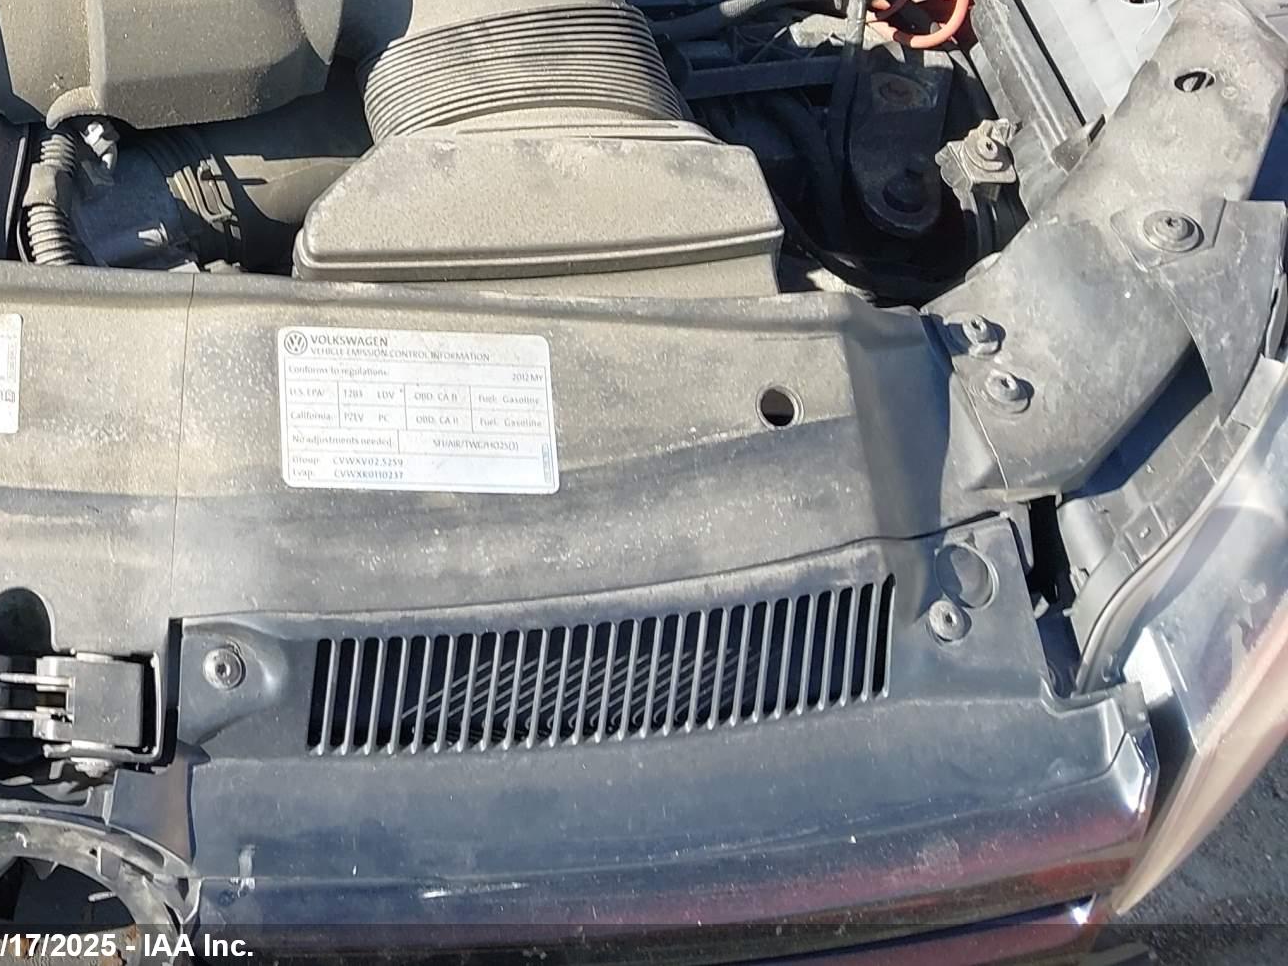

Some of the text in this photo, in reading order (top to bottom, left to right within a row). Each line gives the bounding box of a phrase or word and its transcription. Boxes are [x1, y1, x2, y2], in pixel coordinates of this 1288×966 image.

[310, 335, 389, 347] VOLKSWAGEN
[310, 347, 490, 362] VEHICLE EMISSION CONTROL INFORMATION
[289, 365, 328, 375] Conforms
[292, 434, 305, 443] No
[306, 435, 359, 446] adjustments
